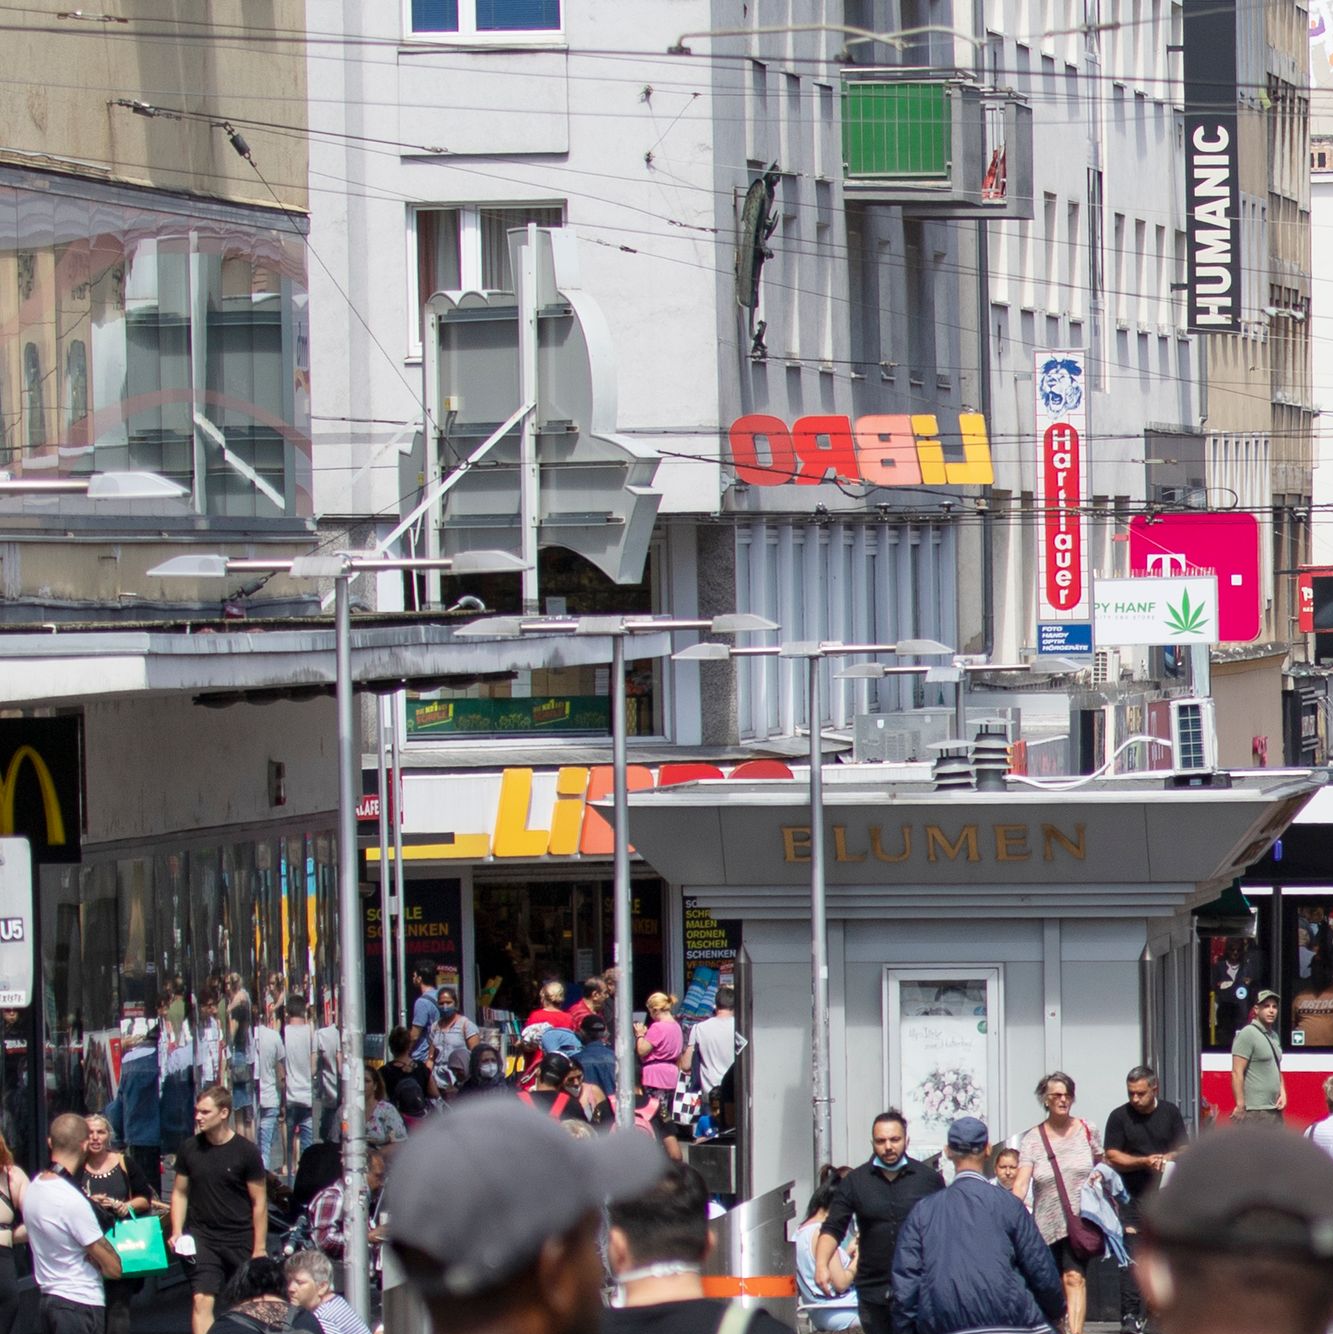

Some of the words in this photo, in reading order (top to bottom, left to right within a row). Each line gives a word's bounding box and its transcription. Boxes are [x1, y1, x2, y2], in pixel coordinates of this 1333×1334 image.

[1192, 125, 1232, 325] HUMANIC
[1115, 602, 1157, 614] HANF
[780, 823, 1088, 865] BLUMEN
[686, 919, 717, 929] MALEN
[686, 929, 725, 939] ORDNEN
[686, 940, 728, 949] TASCHEN
[686, 949, 737, 960] SCHENKEN
